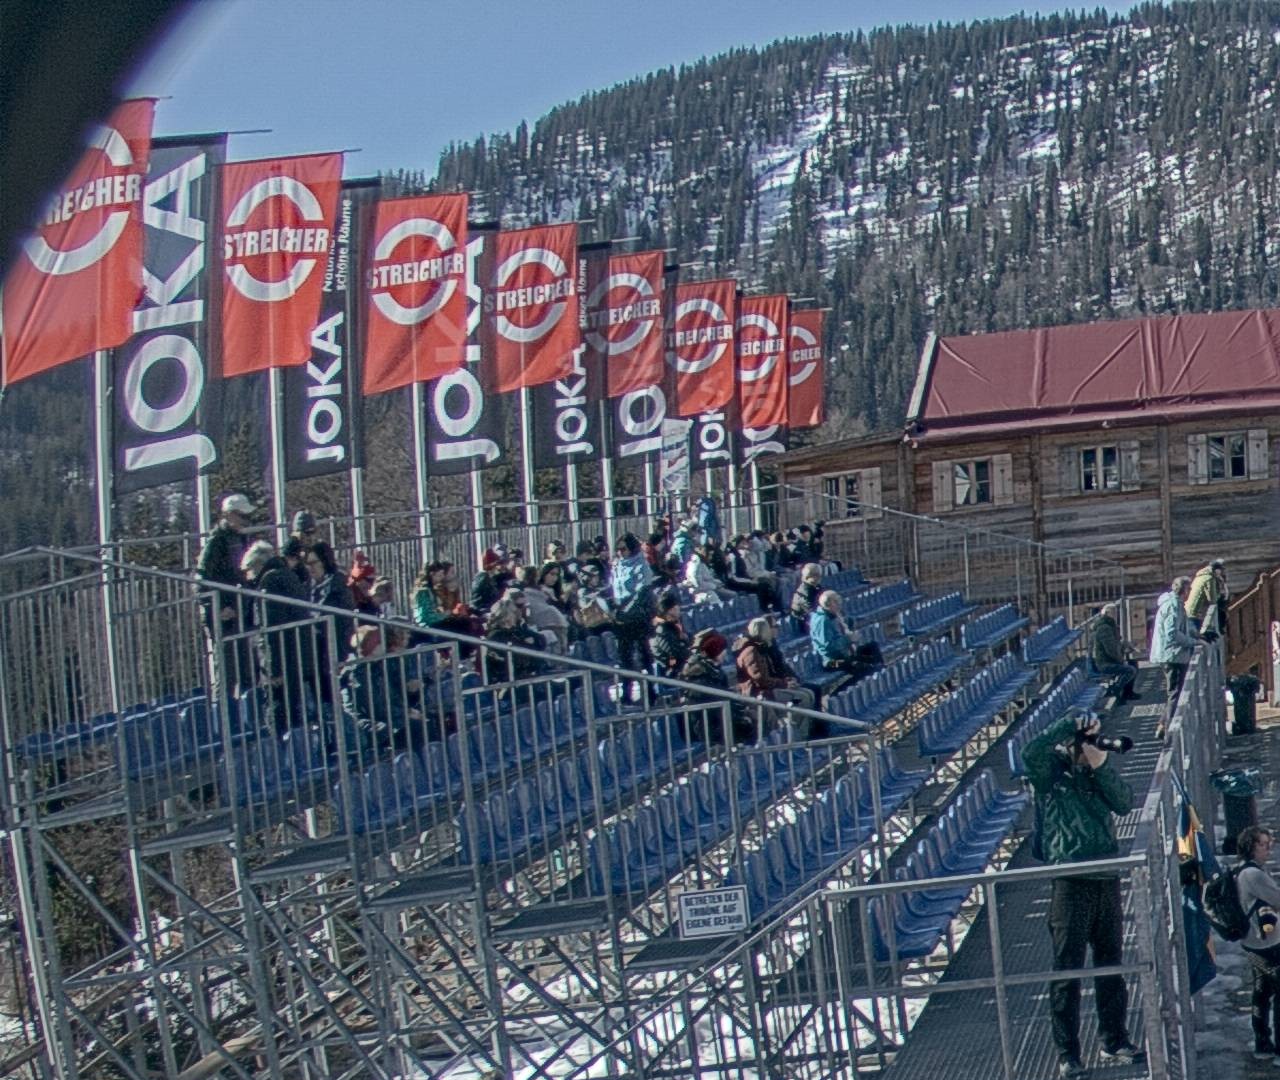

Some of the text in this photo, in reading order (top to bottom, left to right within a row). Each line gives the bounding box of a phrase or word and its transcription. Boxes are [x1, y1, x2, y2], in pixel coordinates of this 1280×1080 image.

[46, 173, 142, 226] REICHER
[224, 228, 329, 260] STREICHER
[367, 253, 464, 290] STREICHER
[125, 152, 217, 472] JOKA
[307, 311, 345, 463] JOKA
